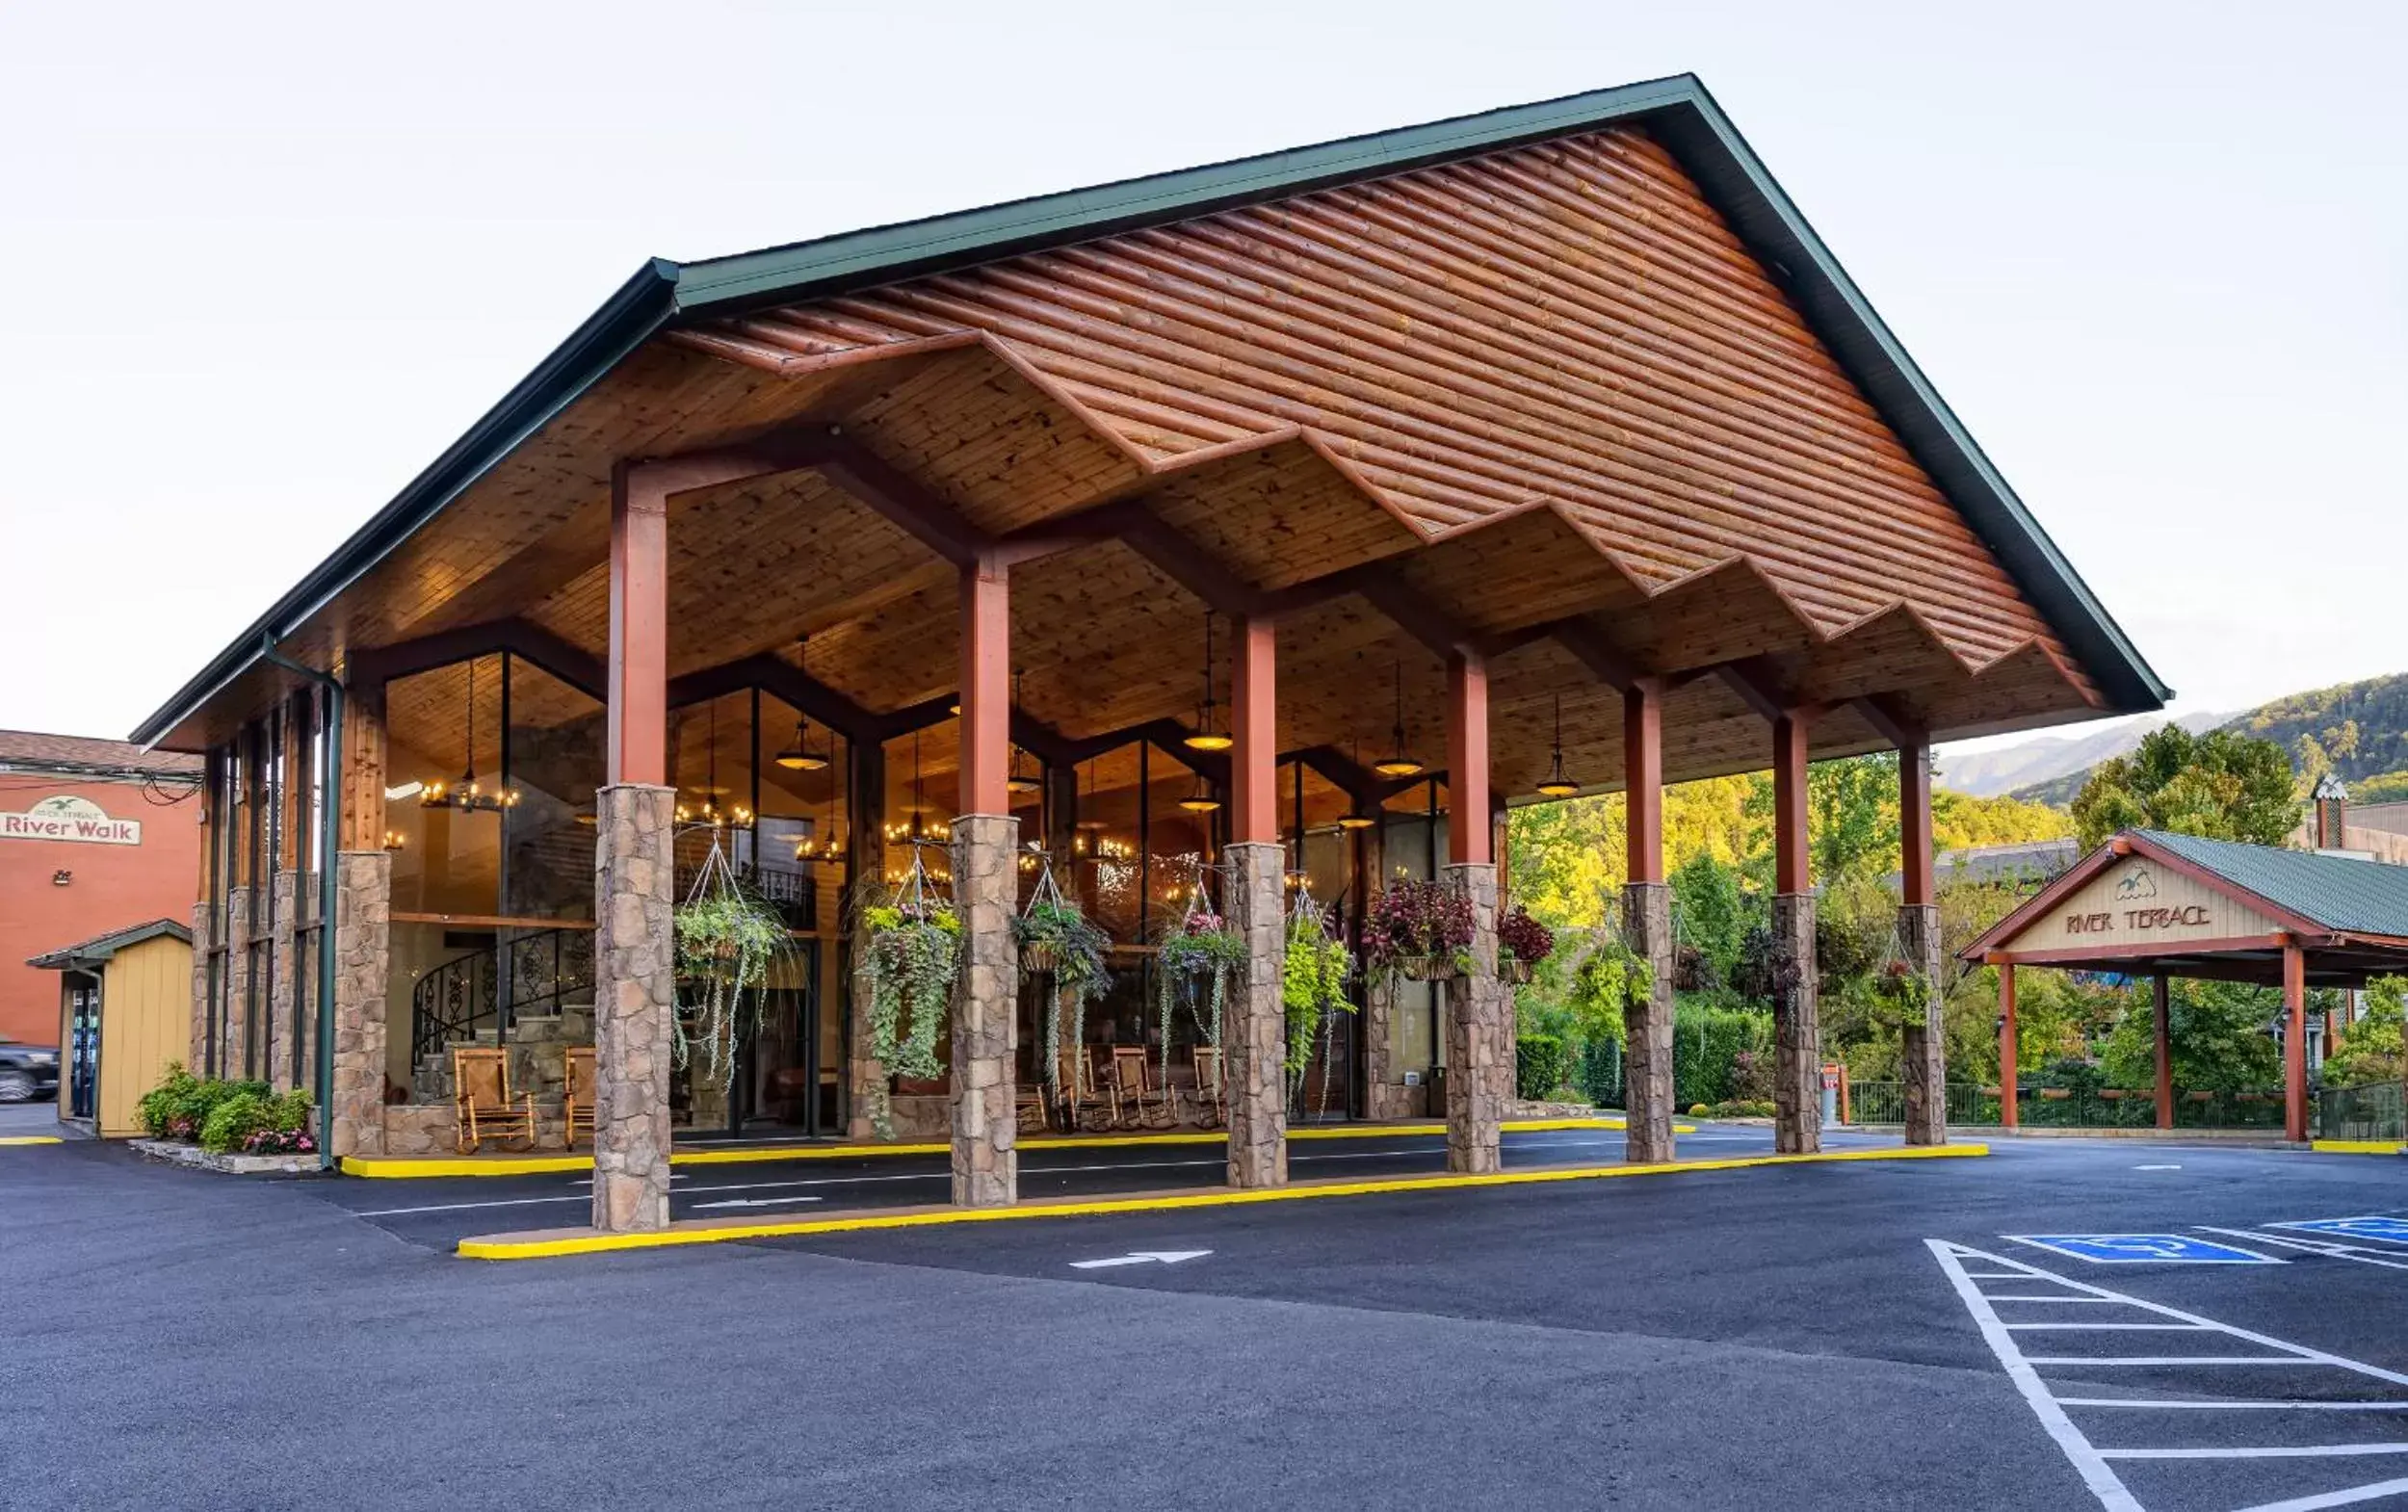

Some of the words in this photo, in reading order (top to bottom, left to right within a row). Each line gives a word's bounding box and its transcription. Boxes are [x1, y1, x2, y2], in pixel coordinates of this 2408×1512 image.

[6, 816, 70, 836] River
[75, 820, 132, 840] Walk
[2066, 912, 2114, 933] RIVER
[2125, 905, 2211, 929] TERRACE
